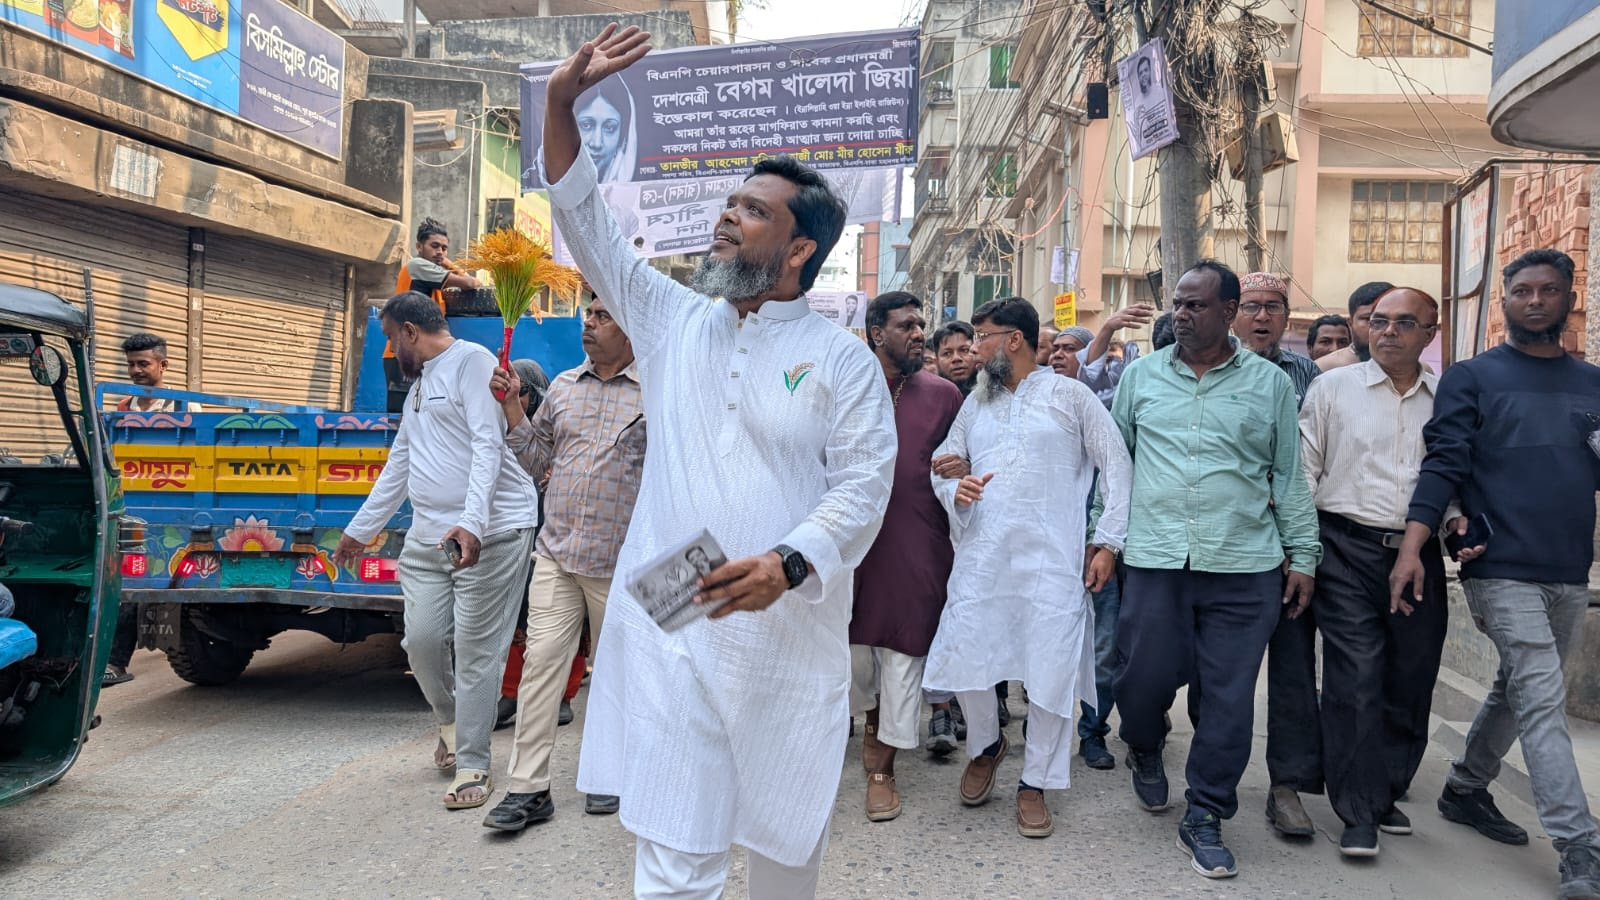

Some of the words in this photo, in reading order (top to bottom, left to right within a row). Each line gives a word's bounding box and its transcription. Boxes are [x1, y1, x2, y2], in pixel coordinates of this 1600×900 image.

[246, 13, 306, 77] বিসমিল্লাহ
[308, 54, 340, 91] স্টোর
[647, 67, 692, 82] বিএনপি
[695, 62, 772, 77] চেয়ারপারসন
[775, 61, 787, 70] ও
[791, 55, 832, 68] সাবেক
[835, 48, 894, 64] প্রধানমন্ত্রী
[652, 86, 710, 109] দেশনেত্রী
[714, 76, 775, 103] বেগম
[781, 68, 856, 98] খালেদা
[862, 61, 916, 90] জিয়া
[652, 110, 713, 126] ইন্তেকাল
[717, 106, 777, 120] করেছেন
[674, 128, 703, 139] আমরা
[707, 125, 726, 137] তাঁর
[759, 118, 809, 133] মাগফিরাত
[811, 116, 843, 129] কামনা
[846, 112, 874, 126] করছি
[876, 113, 900, 125] এবং
[662, 142, 698, 154] সকলের
[701, 138, 726, 152] নিকট
[729, 136, 748, 149] তাঁর
[751, 132, 782, 148] বিদেহী
[786, 132, 820, 145] আত্মার
[823, 130, 844, 142] জন্য
[848, 129, 874, 141] দোয়া
[876, 126, 905, 139] চাচ্ছি
[659, 157, 698, 172] তানভীর
[704, 155, 748, 170] আহম্মেদ
[813, 148, 834, 160] মোঃ
[837, 144, 854, 159] মীর
[857, 145, 891, 159] হোসেন
[123, 461, 191, 489] থামুন
[228, 462, 292, 476] TATA
[326, 464, 385, 482] STO
[139, 624, 175, 636] TATA
